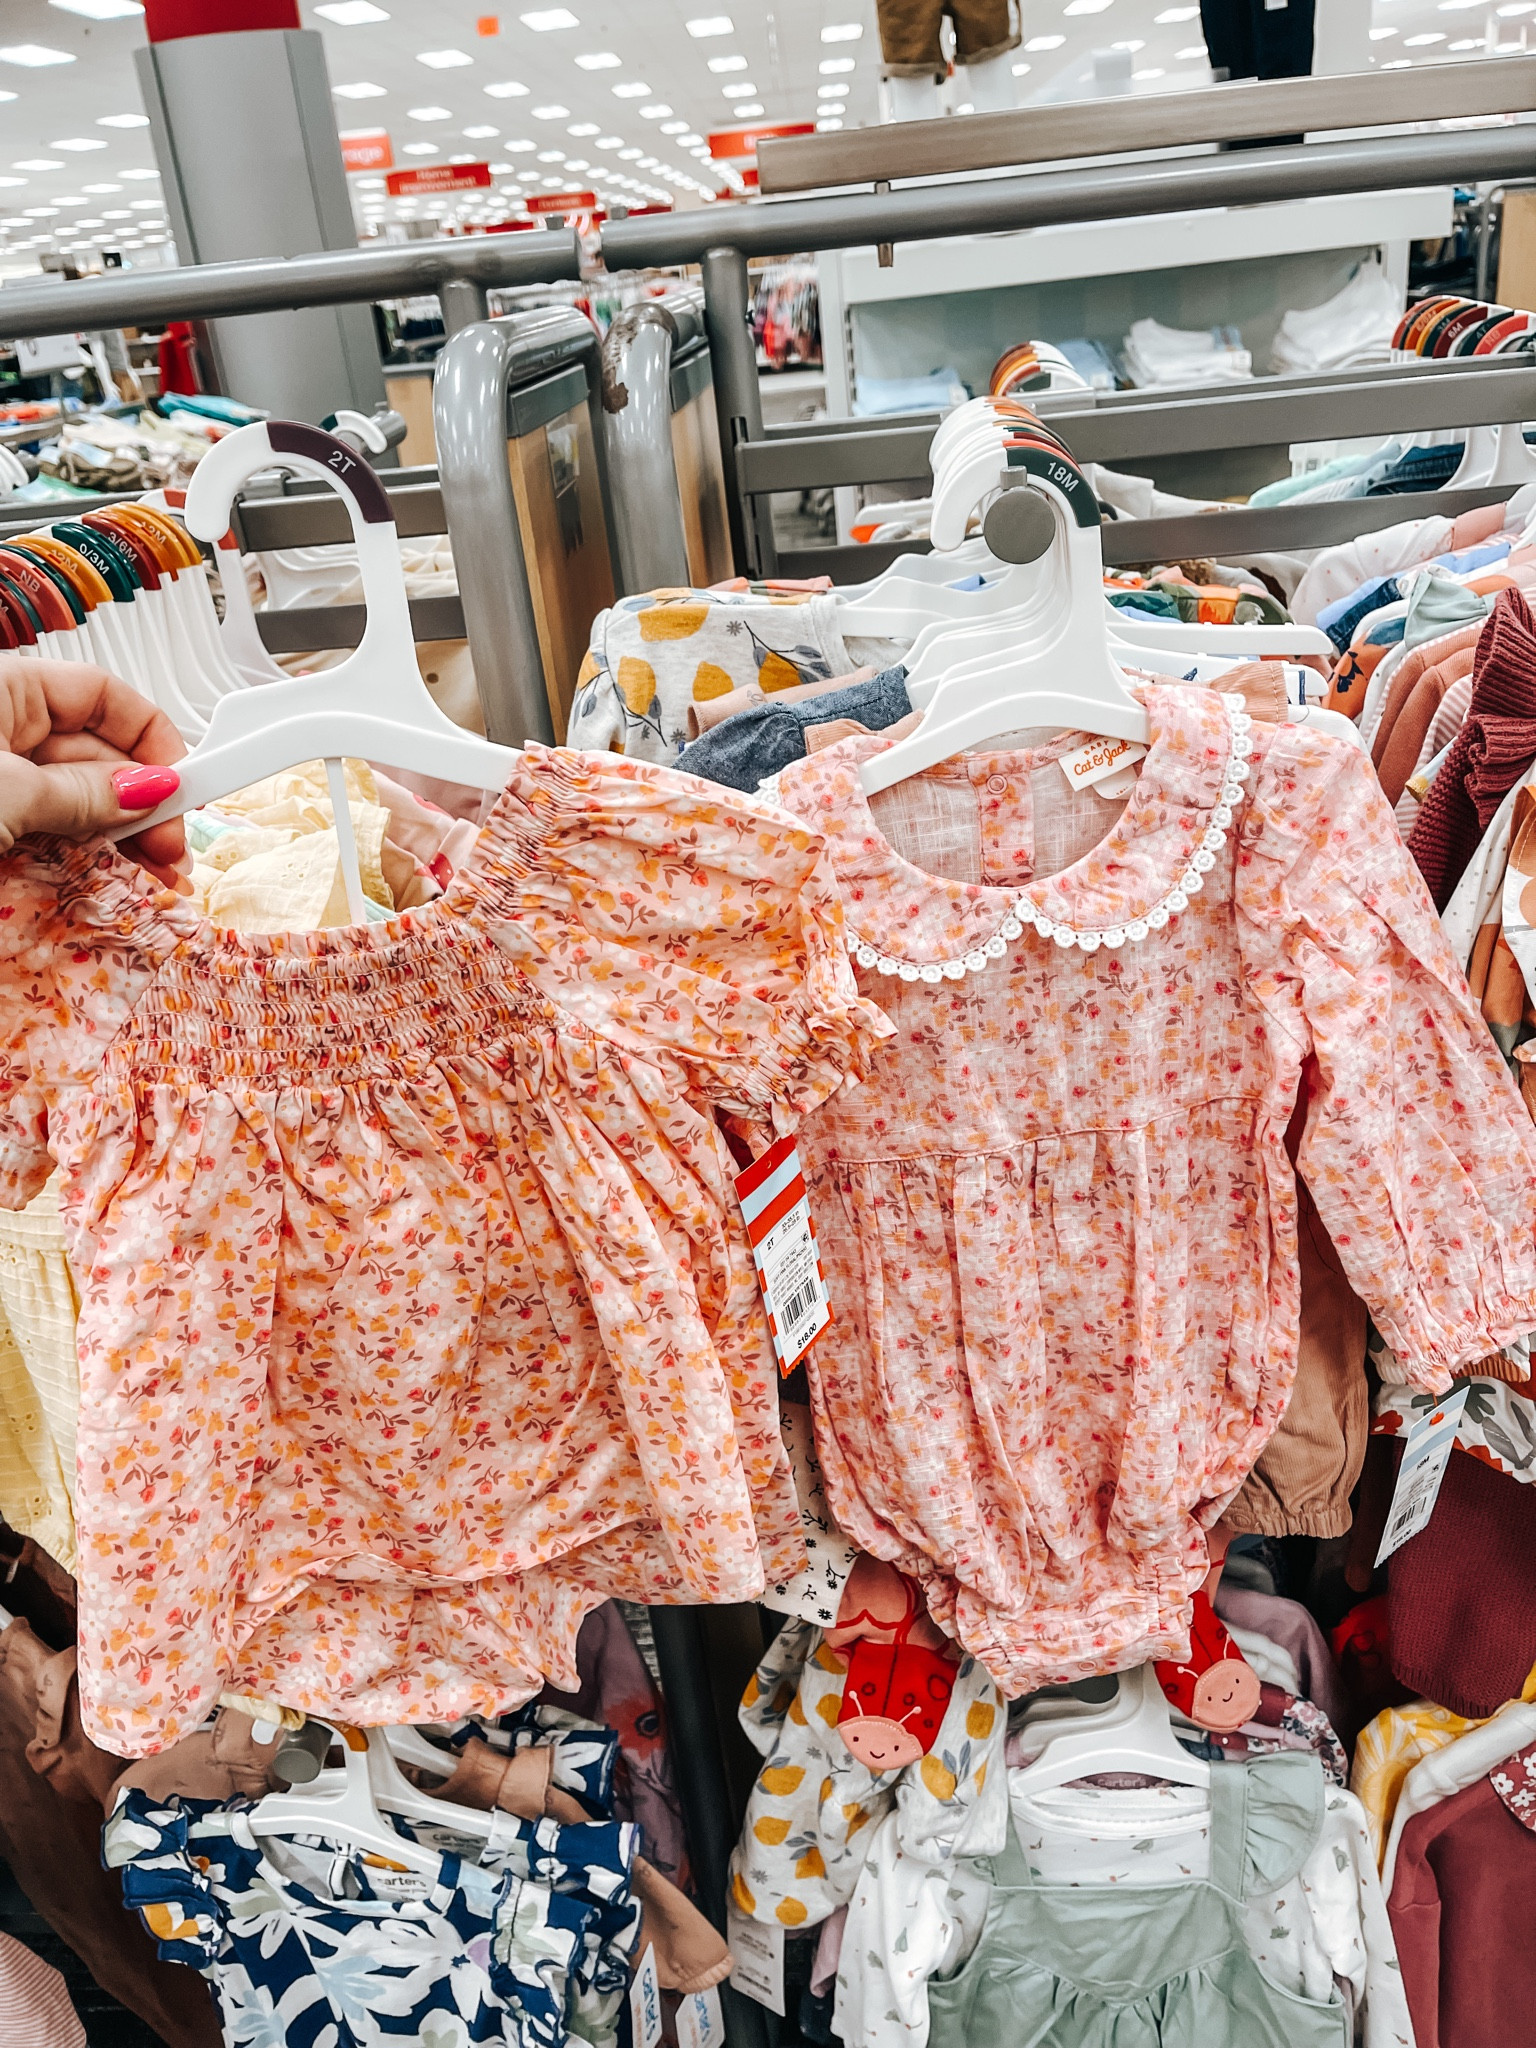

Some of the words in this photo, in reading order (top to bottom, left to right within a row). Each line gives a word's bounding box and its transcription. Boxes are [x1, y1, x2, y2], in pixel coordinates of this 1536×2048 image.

[1447, 321, 1464, 339] 6M
[327, 450, 357, 474] 2T
[1047, 461, 1080, 492] 18M
[79, 543, 110, 575] 0/3M
[108, 531, 138, 562] 3/6M
[20, 569, 41, 593] NB
[1073, 759, 1095, 776] Cat
[1092, 752, 1104, 767] &
[1102, 740, 1132, 767] Jack
[766, 1236, 775, 1251] 2T
[796, 1322, 817, 1349] $18.00
